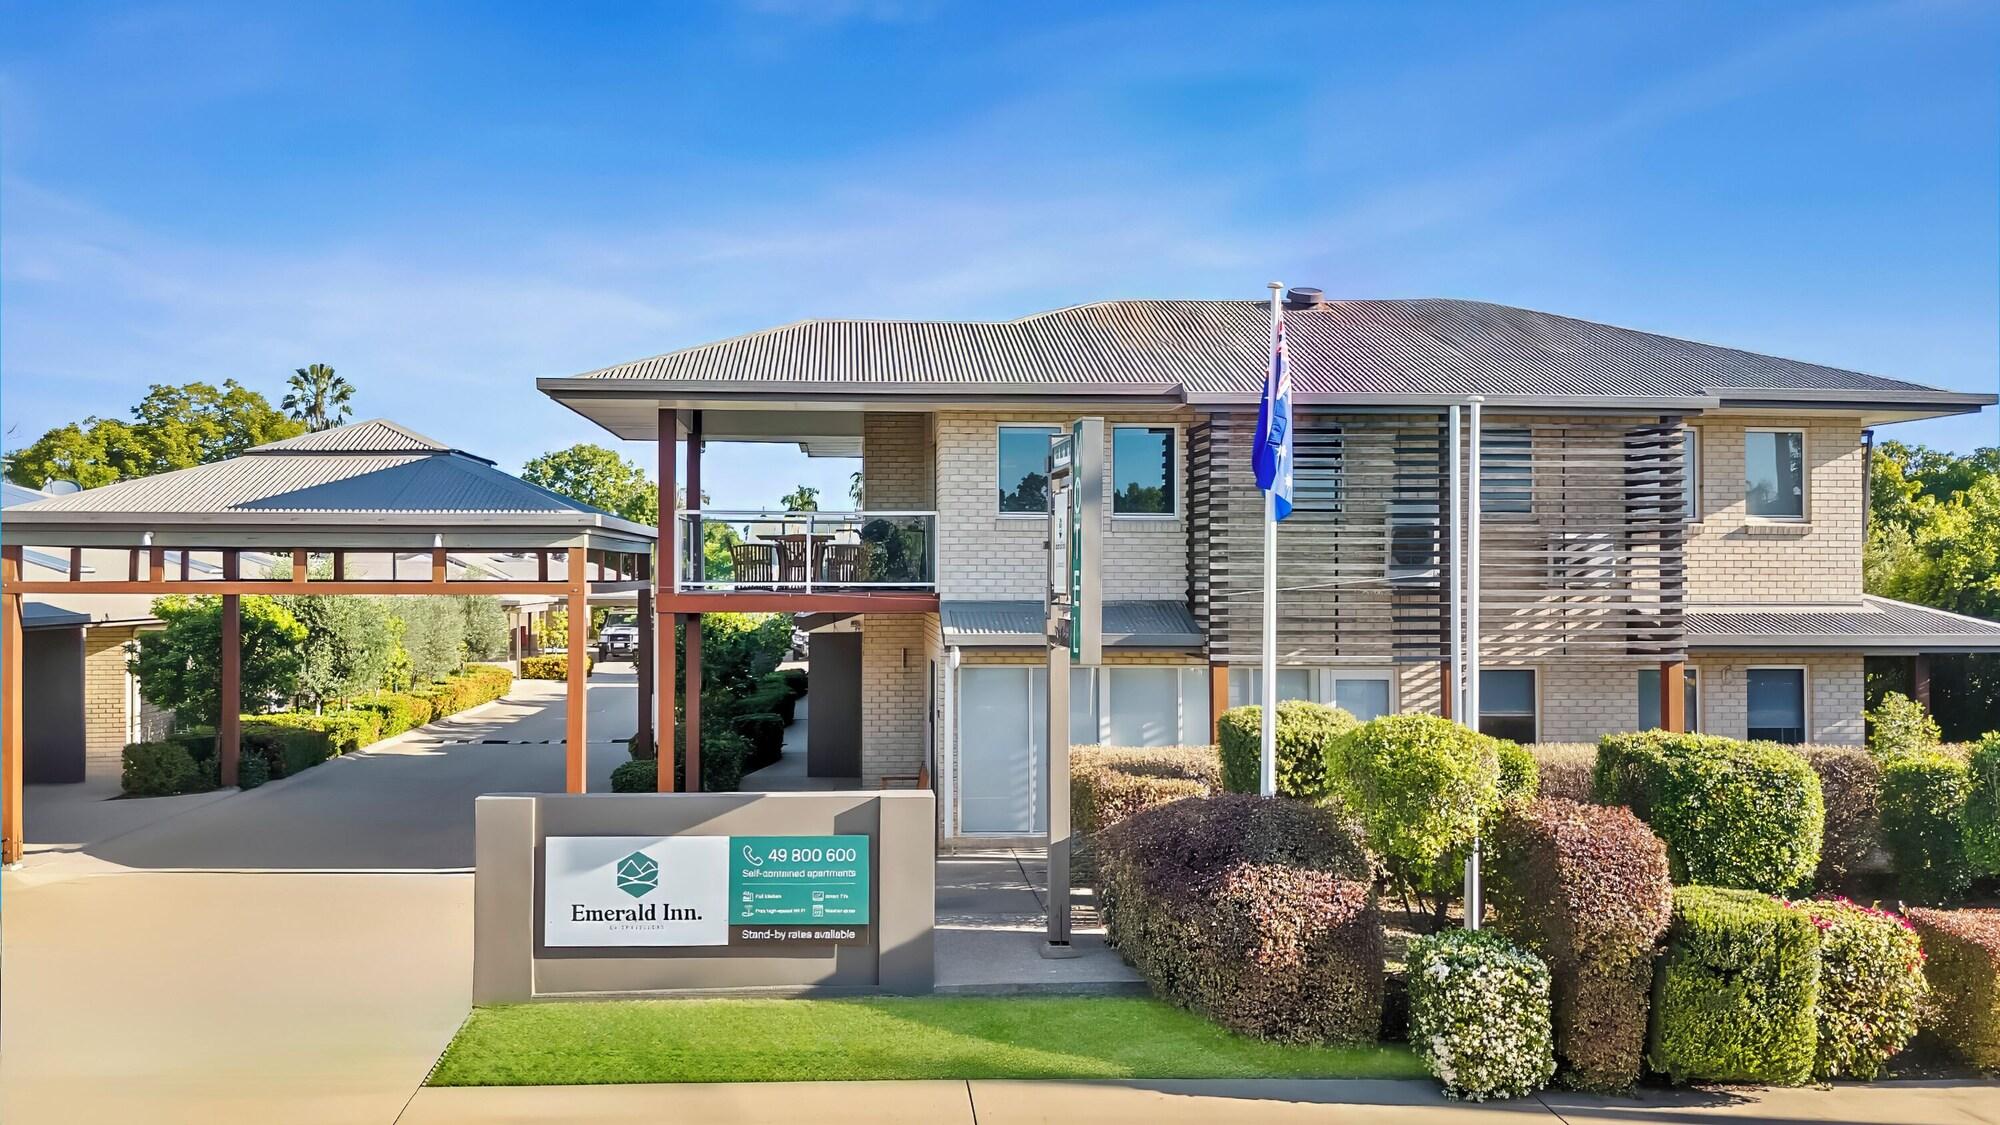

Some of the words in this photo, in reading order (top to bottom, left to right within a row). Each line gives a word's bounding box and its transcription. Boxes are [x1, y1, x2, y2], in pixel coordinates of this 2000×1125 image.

[1073, 427, 1083, 653] MOTEL
[768, 848, 787, 862] 49
[791, 848, 822, 862] 800
[825, 848, 857, 862] 600
[742, 868, 805, 878] Self-contained
[807, 869, 856, 879] apartments
[571, 904, 656, 922] Emerald
[663, 903, 703, 921] Inn.
[742, 929, 786, 940] Stand-by
[788, 930, 812, 939] rates
[814, 929, 856, 939] available
